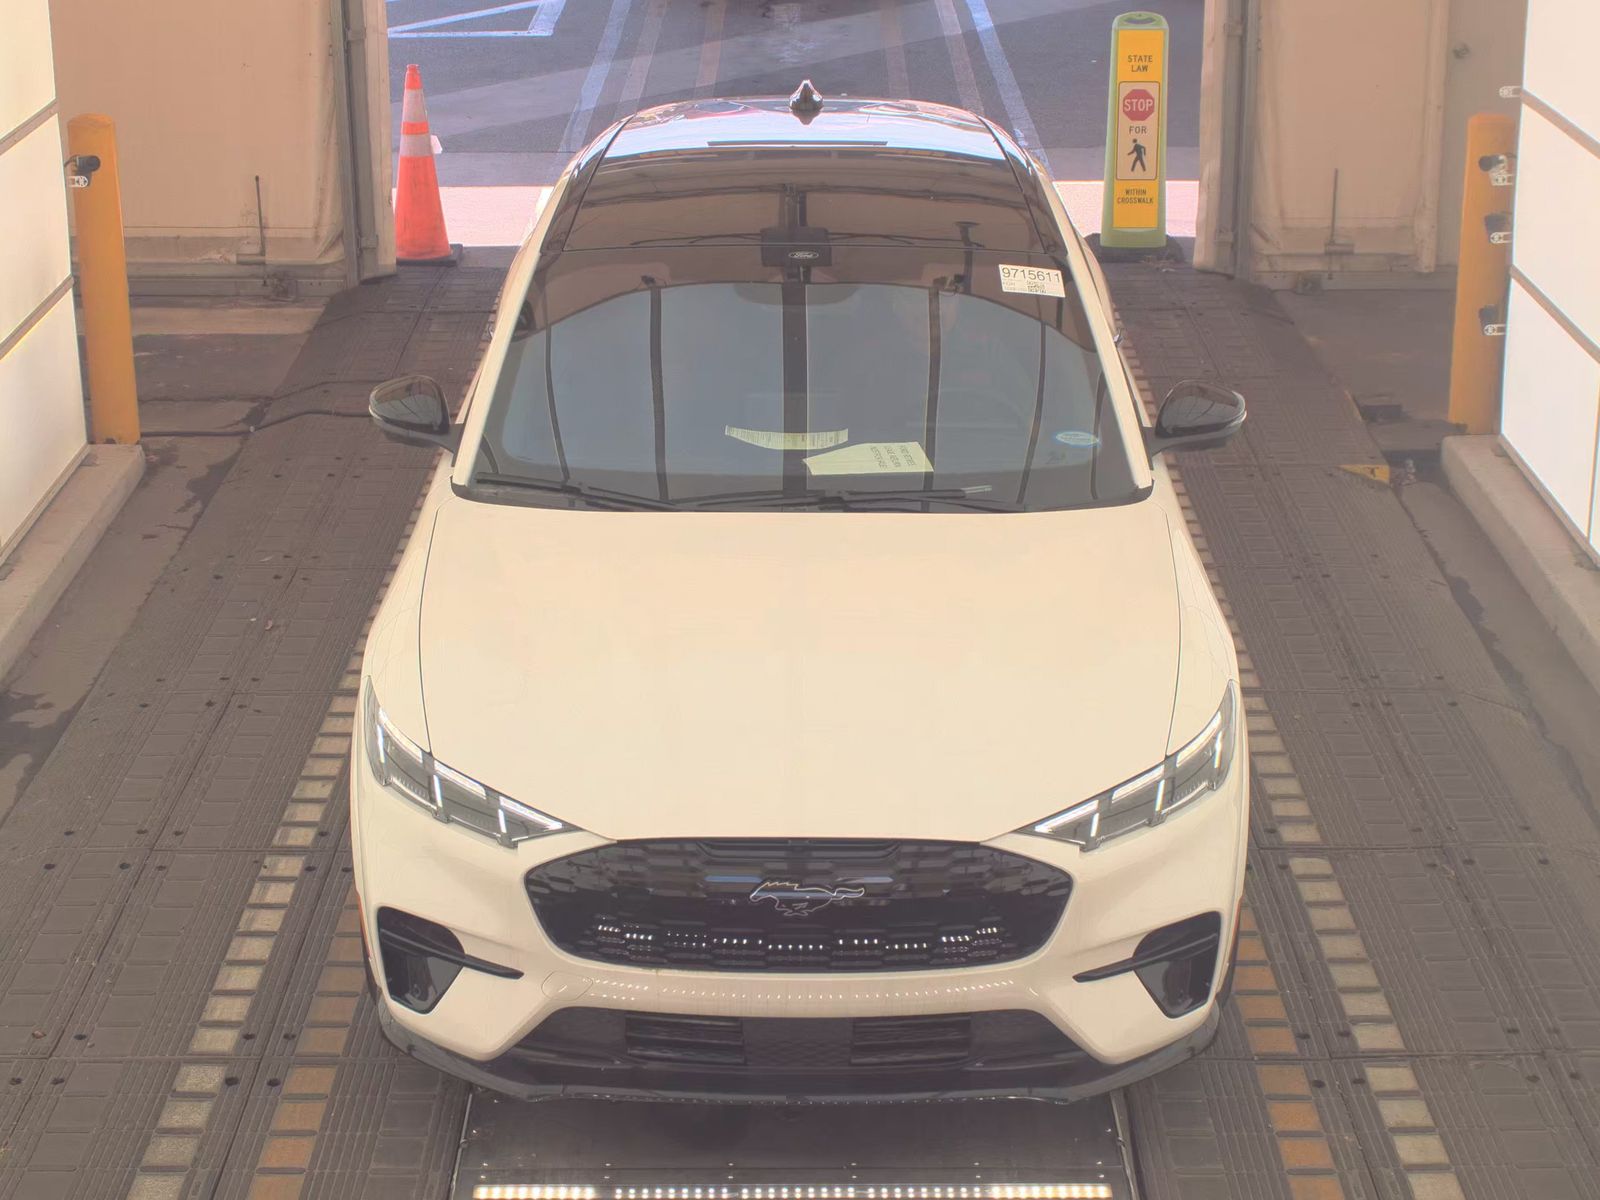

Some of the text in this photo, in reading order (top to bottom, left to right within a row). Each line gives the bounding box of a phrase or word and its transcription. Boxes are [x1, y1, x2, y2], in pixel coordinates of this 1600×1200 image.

[1127, 54, 1153, 63] STATE
[1131, 64, 1149, 73] LAW
[1124, 98, 1154, 111] STOP
[1128, 126, 1147, 134] FOR
[1125, 188, 1147, 196] WITHIN
[1001, 267, 1060, 283] 9715611
